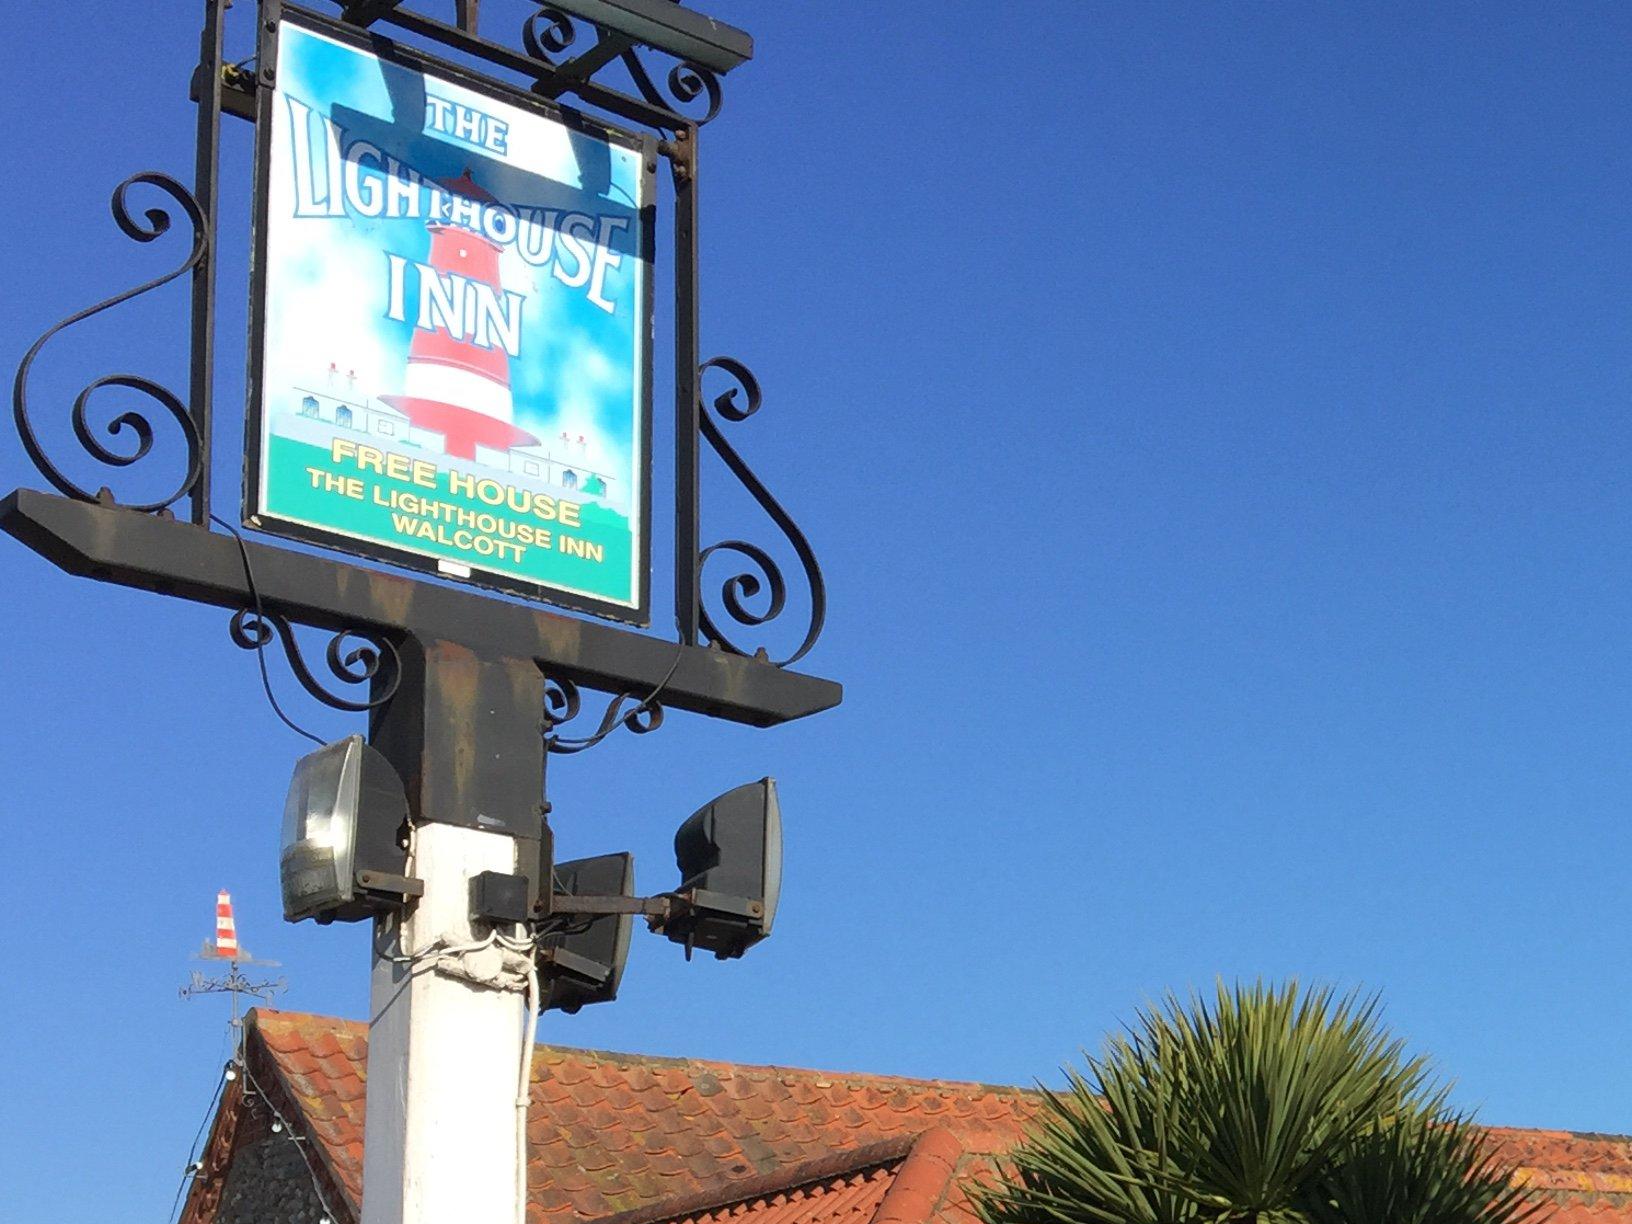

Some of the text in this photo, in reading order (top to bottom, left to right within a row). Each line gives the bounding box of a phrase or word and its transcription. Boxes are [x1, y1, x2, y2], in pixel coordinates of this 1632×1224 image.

[424, 92, 510, 157] THE
[284, 92, 632, 316] LIGHTHOUSE
[382, 249, 527, 359] INN
[306, 466, 604, 564] THE LIGHTHOUSE INN
[331, 437, 582, 529] FREE HOUSE
[391, 511, 528, 564] WALCOTT
